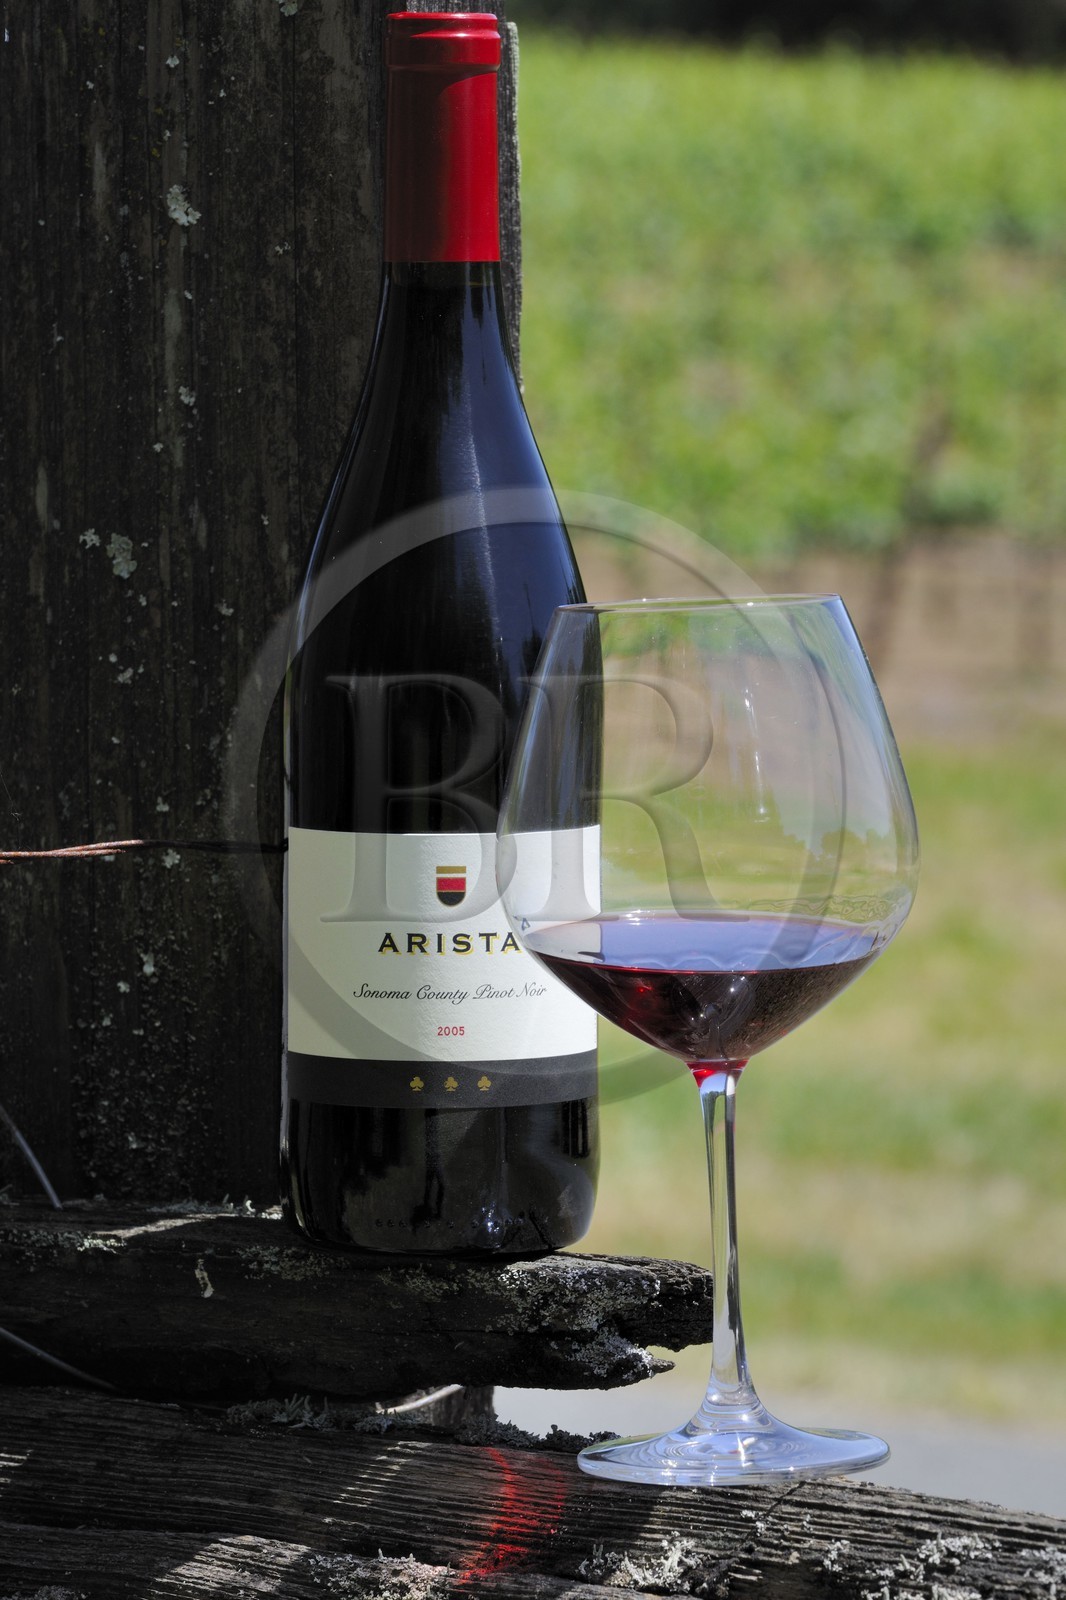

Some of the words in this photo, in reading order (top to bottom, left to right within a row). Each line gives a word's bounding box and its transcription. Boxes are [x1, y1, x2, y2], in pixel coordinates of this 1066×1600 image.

[377, 931, 522, 956] ARISTA
[352, 982, 412, 1001] Sonoma
[416, 984, 470, 1006] County
[472, 983, 515, 1001] Pinot
[515, 981, 548, 999] Noir
[436, 1025, 466, 1037] 2005
